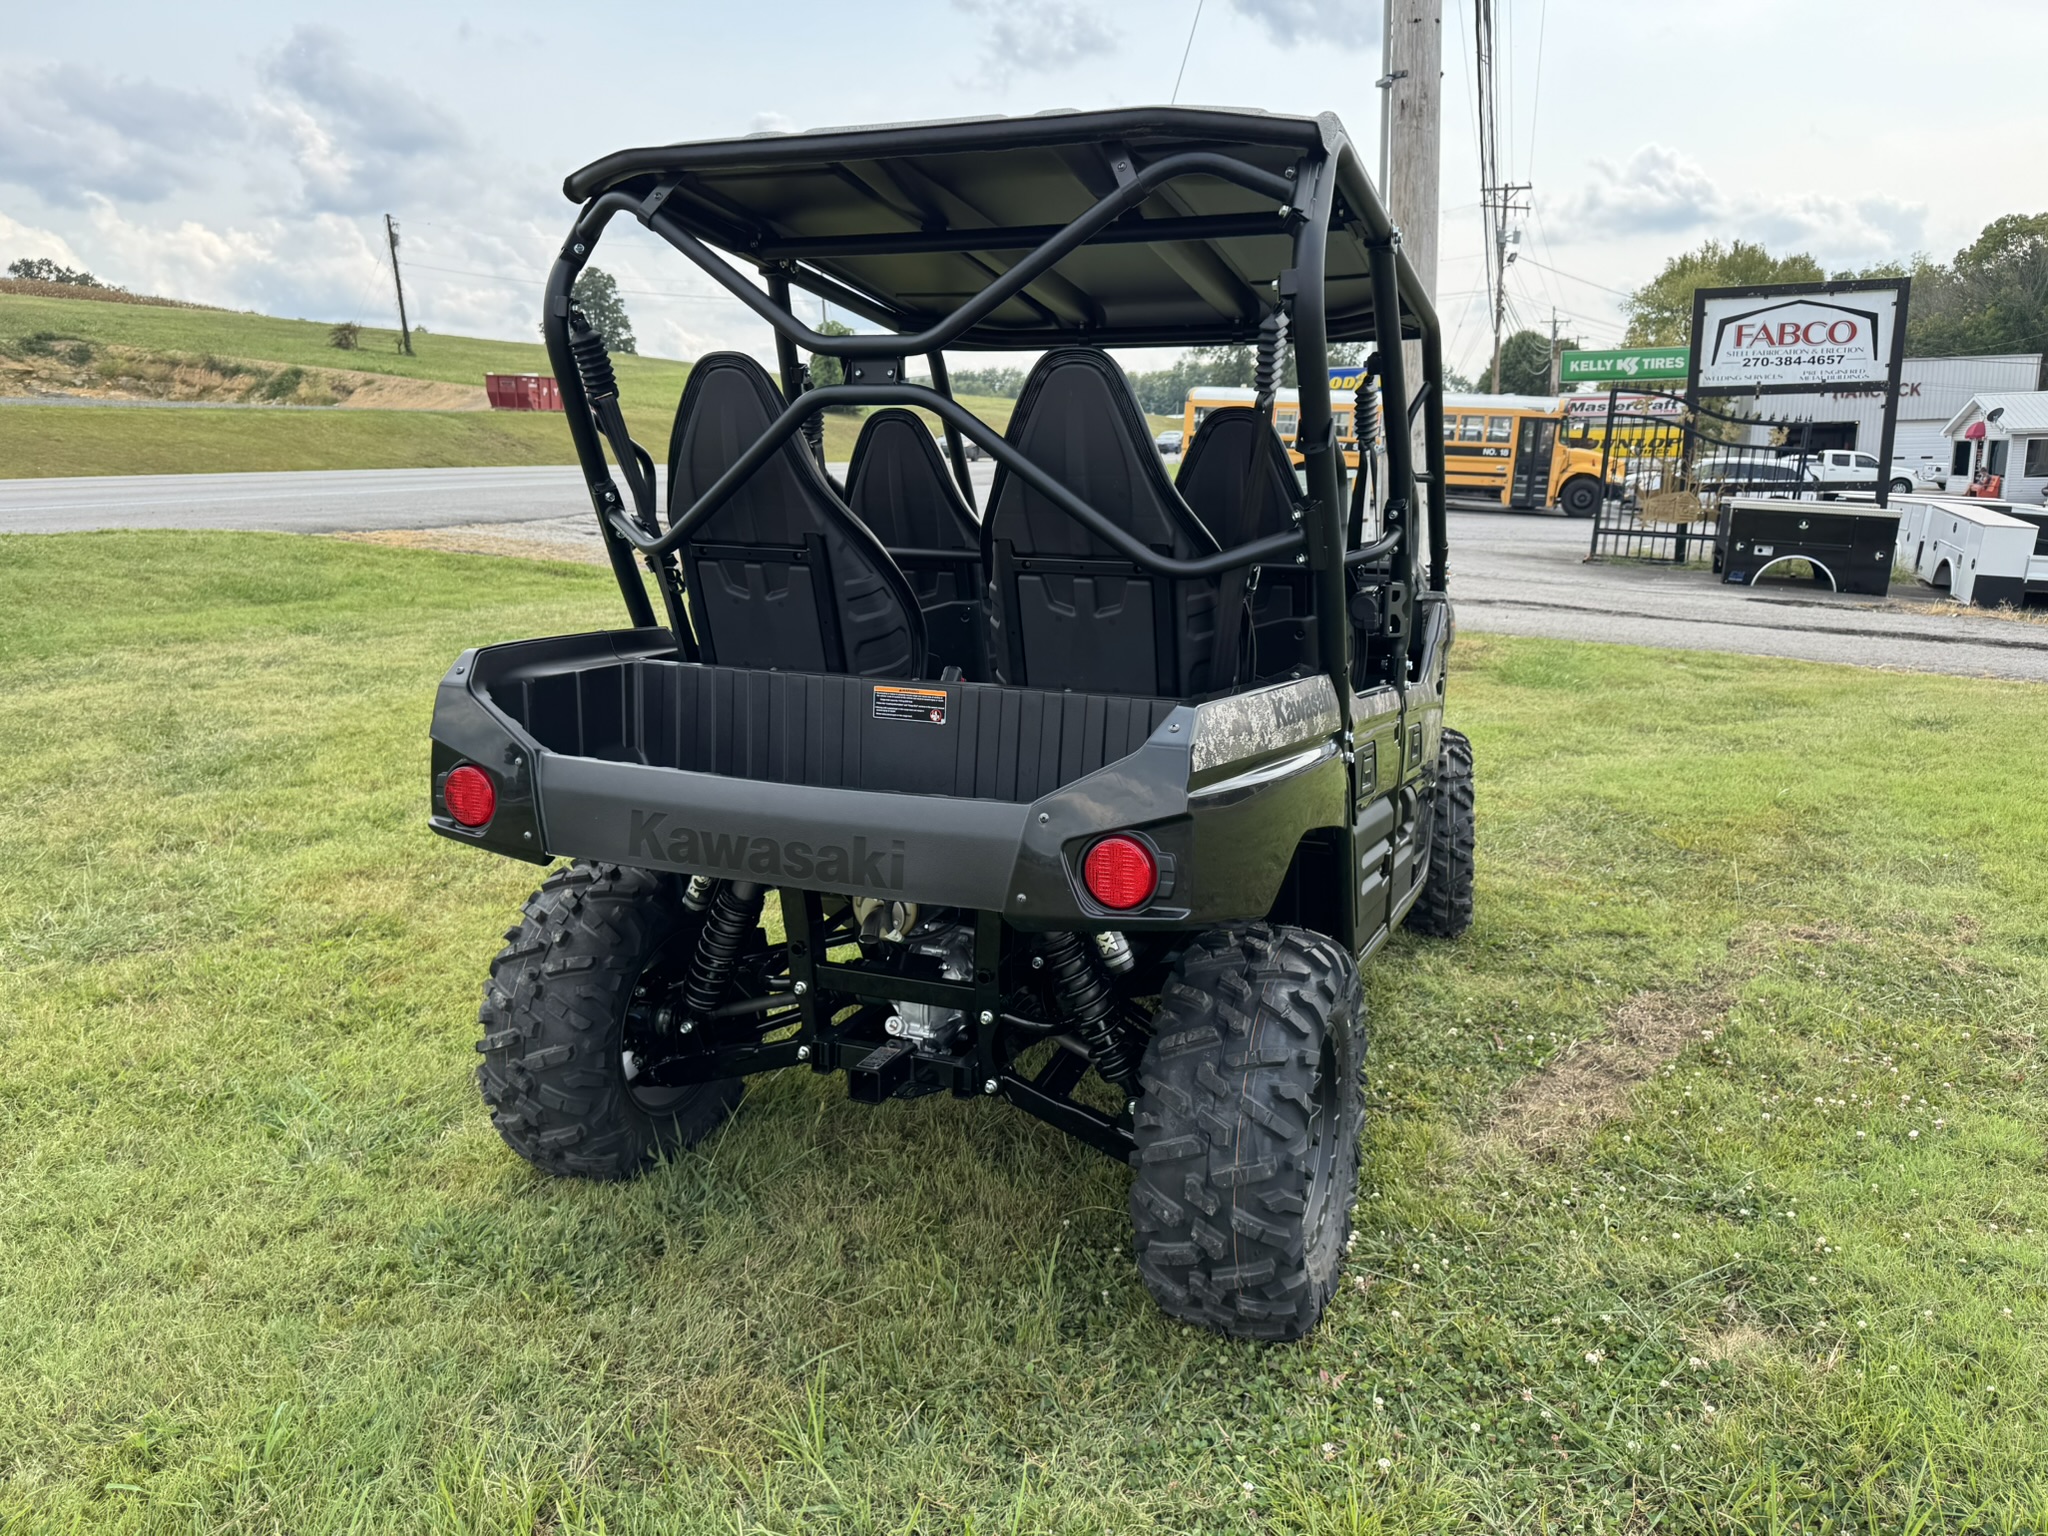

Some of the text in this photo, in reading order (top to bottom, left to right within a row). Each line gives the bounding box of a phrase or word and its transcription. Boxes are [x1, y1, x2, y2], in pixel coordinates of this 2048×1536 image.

[1733, 321, 1858, 349] FABCO
[1752, 349, 1810, 357] FABRICATION
[1570, 359, 1613, 372] KELLY
[1642, 357, 1685, 369] TIRES
[1742, 355, 1845, 367] 270-384-4657
[1482, 447, 1497, 456] NO.
[628, 808, 905, 890] Kawasaki
